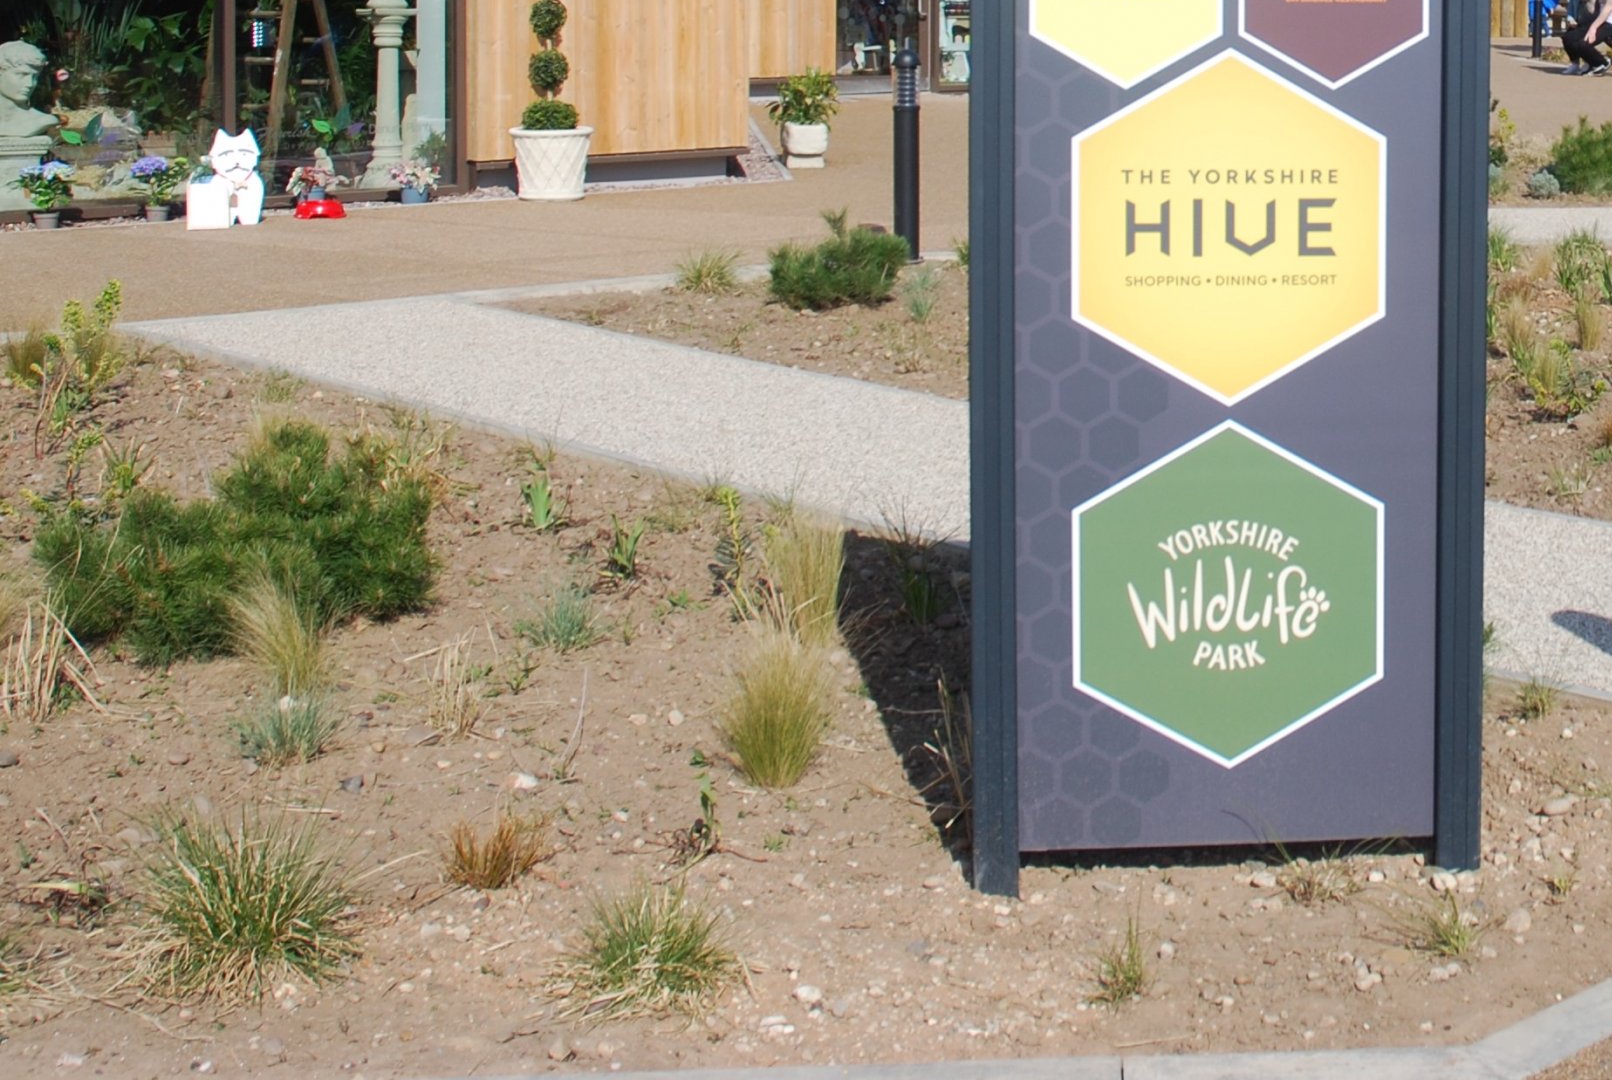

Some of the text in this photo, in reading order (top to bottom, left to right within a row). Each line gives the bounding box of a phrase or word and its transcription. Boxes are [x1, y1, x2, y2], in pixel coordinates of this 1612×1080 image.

[1121, 169, 1340, 185] THE YORKSHIRE
[1125, 197, 1337, 257] HIVE
[1125, 273, 1337, 288] SHOPPING DINING RESORT
[1157, 520, 1300, 562] YORKSHIRE
[1192, 639, 1267, 671] PARK
